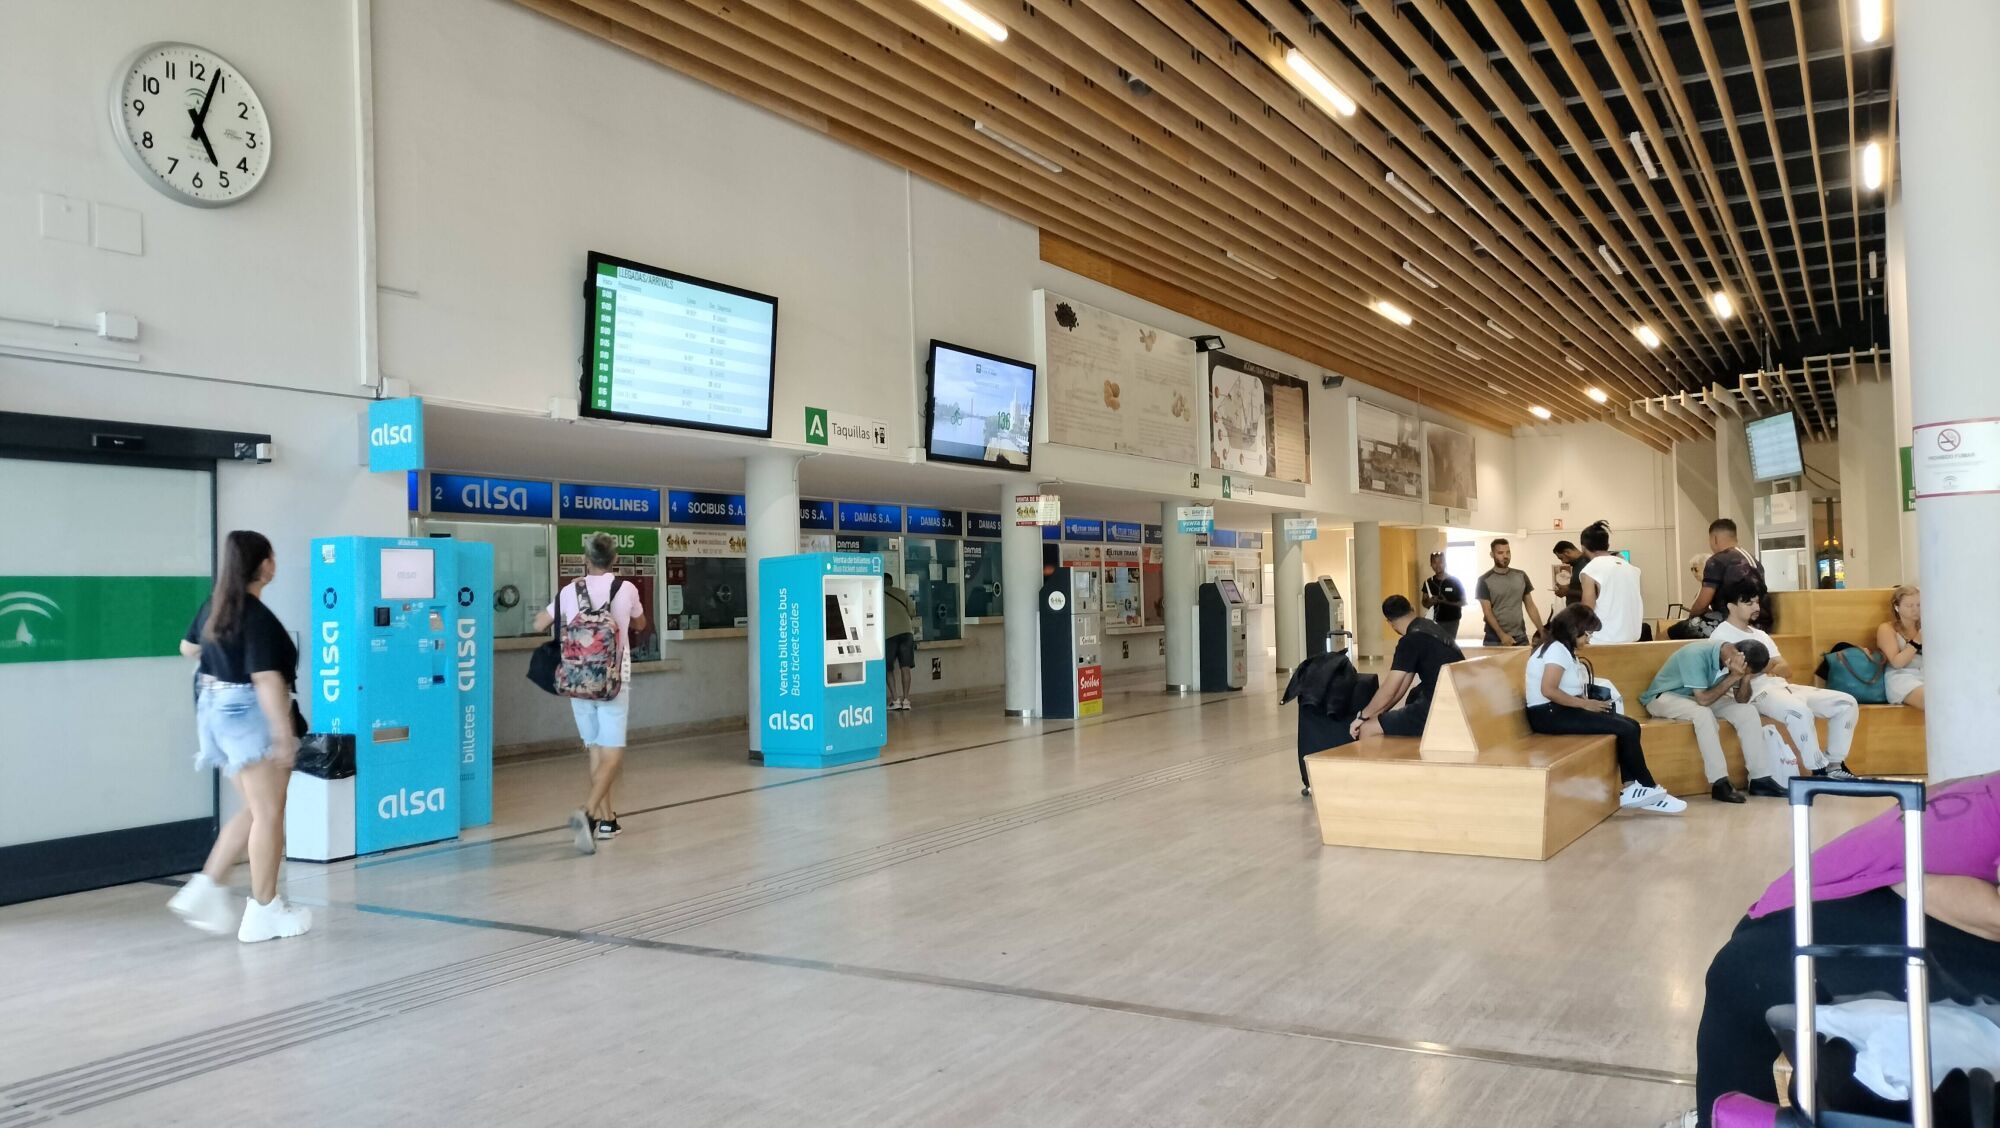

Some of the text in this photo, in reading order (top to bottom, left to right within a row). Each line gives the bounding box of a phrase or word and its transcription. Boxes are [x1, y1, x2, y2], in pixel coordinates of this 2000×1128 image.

[165, 61, 176, 80] 11
[190, 61, 206, 81] 12
[142, 74, 160, 95] 10
[221, 77, 225, 94] 1
[133, 99, 145, 117] 9
[238, 102, 249, 120] 2
[142, 131, 154, 149] 8
[245, 131, 257, 149] 3
[167, 157, 179, 175] 7
[236, 157, 249, 174] 4
[192, 172, 203, 189] 6
[219, 171, 230, 188] 5
[997, 411, 1011, 430] 136
[371, 424, 412, 446] alsa
[832, 423, 871, 441] Taquillas
[435, 480, 527, 511] 2 alsa
[563, 496, 649, 512] 3 EUROLINES
[671, 501, 746, 516] 4 SOCIBUS S.A.
[812, 509, 827, 521] S.A.
[840, 511, 892, 524] 6 DAMAS S.A.
[908, 515, 954, 528] 7 DAMAS S.A.
[978, 519, 996, 529] DAMAS
[778, 587, 788, 697] Venta billetes bus
[790, 602, 800, 697] Bus ticket sales
[320, 621, 340, 702] alsa
[457, 618, 476, 692] alsa
[769, 710, 814, 731] alsa
[839, 705, 873, 728] alsa
[462, 704, 475, 763] billetes
[378, 787, 445, 819] alsa
